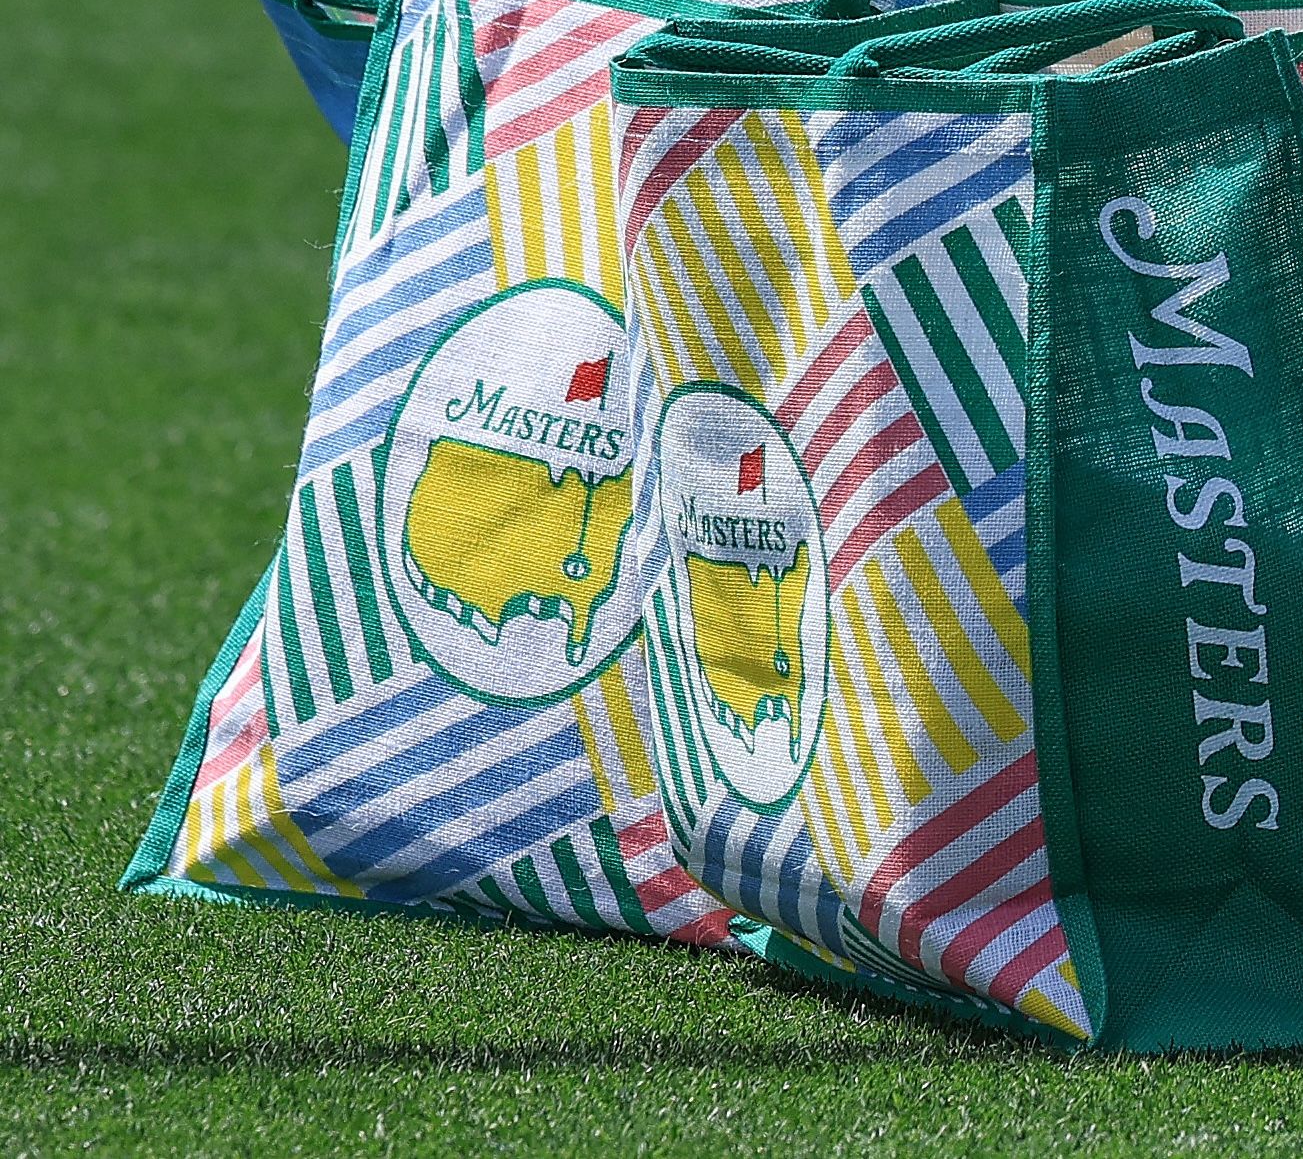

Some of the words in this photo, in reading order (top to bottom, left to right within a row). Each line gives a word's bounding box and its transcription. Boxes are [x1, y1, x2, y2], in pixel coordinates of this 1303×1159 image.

[446, 379, 626, 459] MASTERS
[678, 494, 786, 553] MASTERS
[1098, 195, 1280, 832] MASTERS
